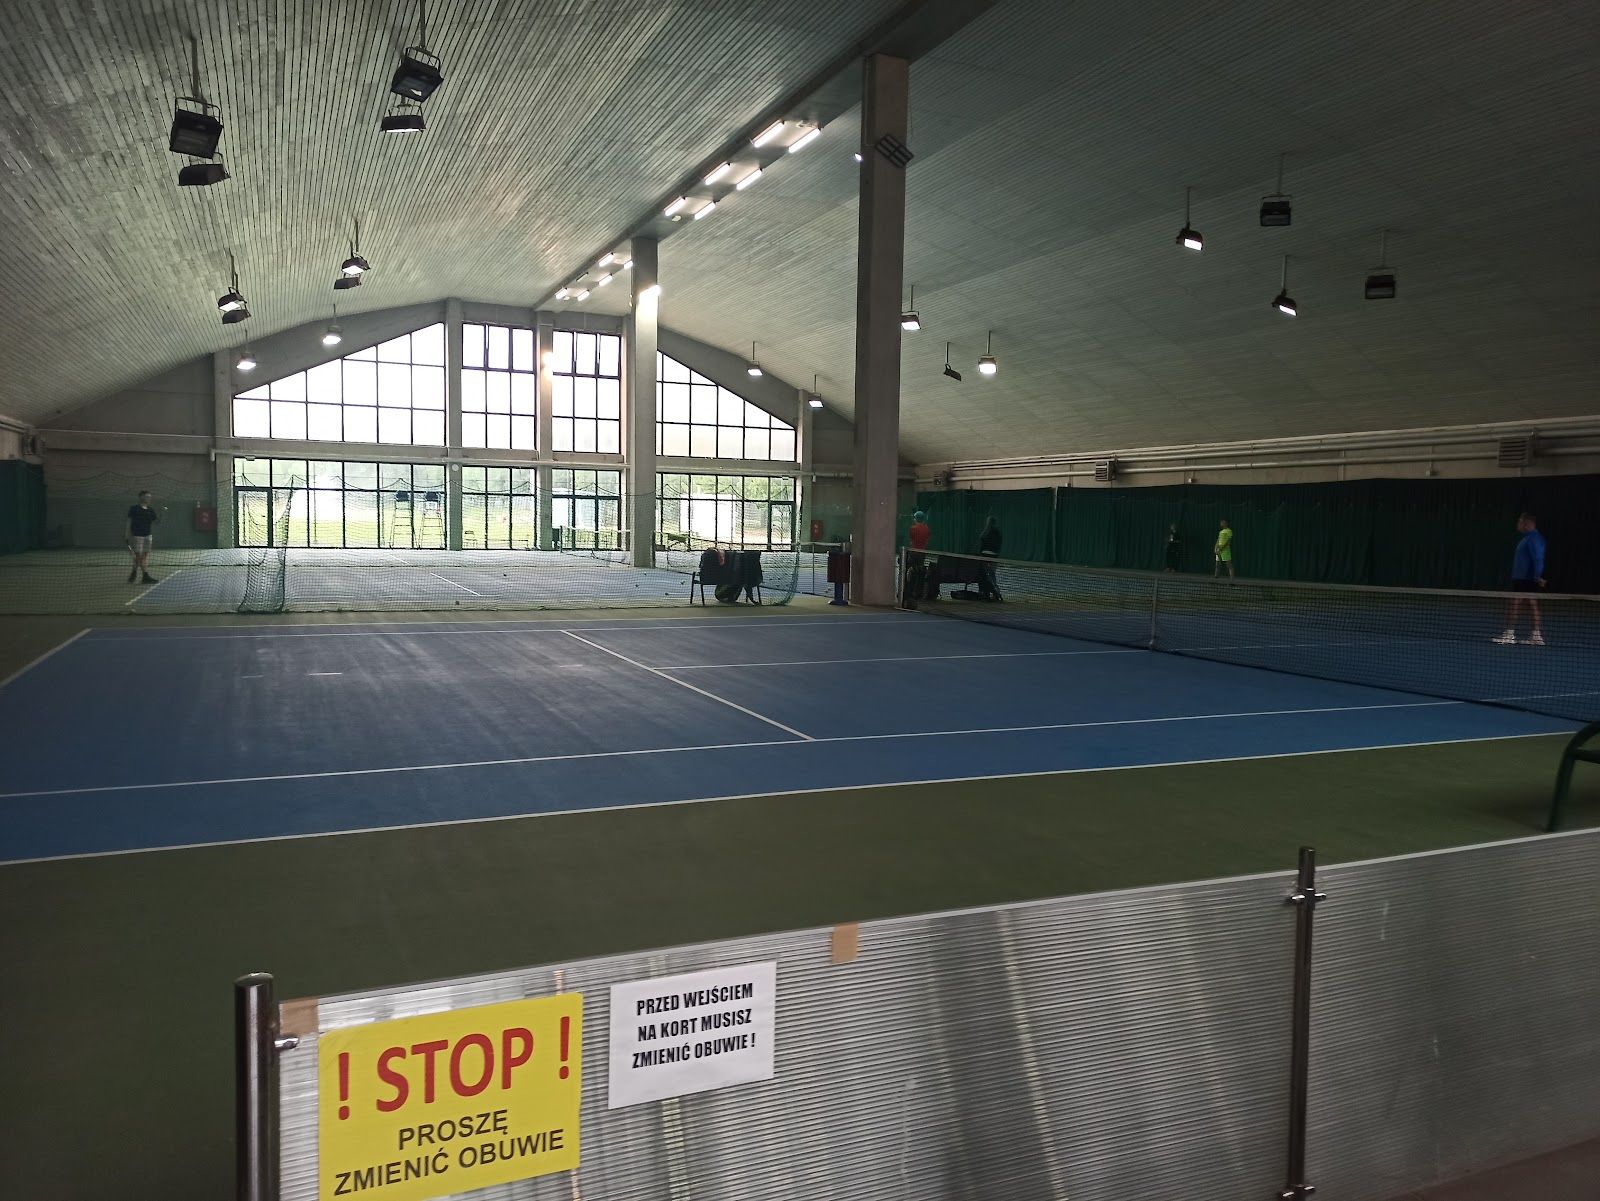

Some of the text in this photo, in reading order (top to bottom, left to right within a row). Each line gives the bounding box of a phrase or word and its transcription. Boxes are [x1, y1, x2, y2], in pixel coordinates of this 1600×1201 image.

[636, 982, 753, 1016] PRZED WEJŚCIEM
[637, 1008, 752, 1042] NA KORT MUSISZ
[338, 1015, 570, 1121] ! STOP !
[632, 1042, 691, 1069] ZMIENIĆ
[694, 1034, 748, 1059] OBUWIE
[399, 1109, 508, 1151] PROSZĘ
[334, 1128, 564, 1196] ZMIENIĆ OBUWIE
